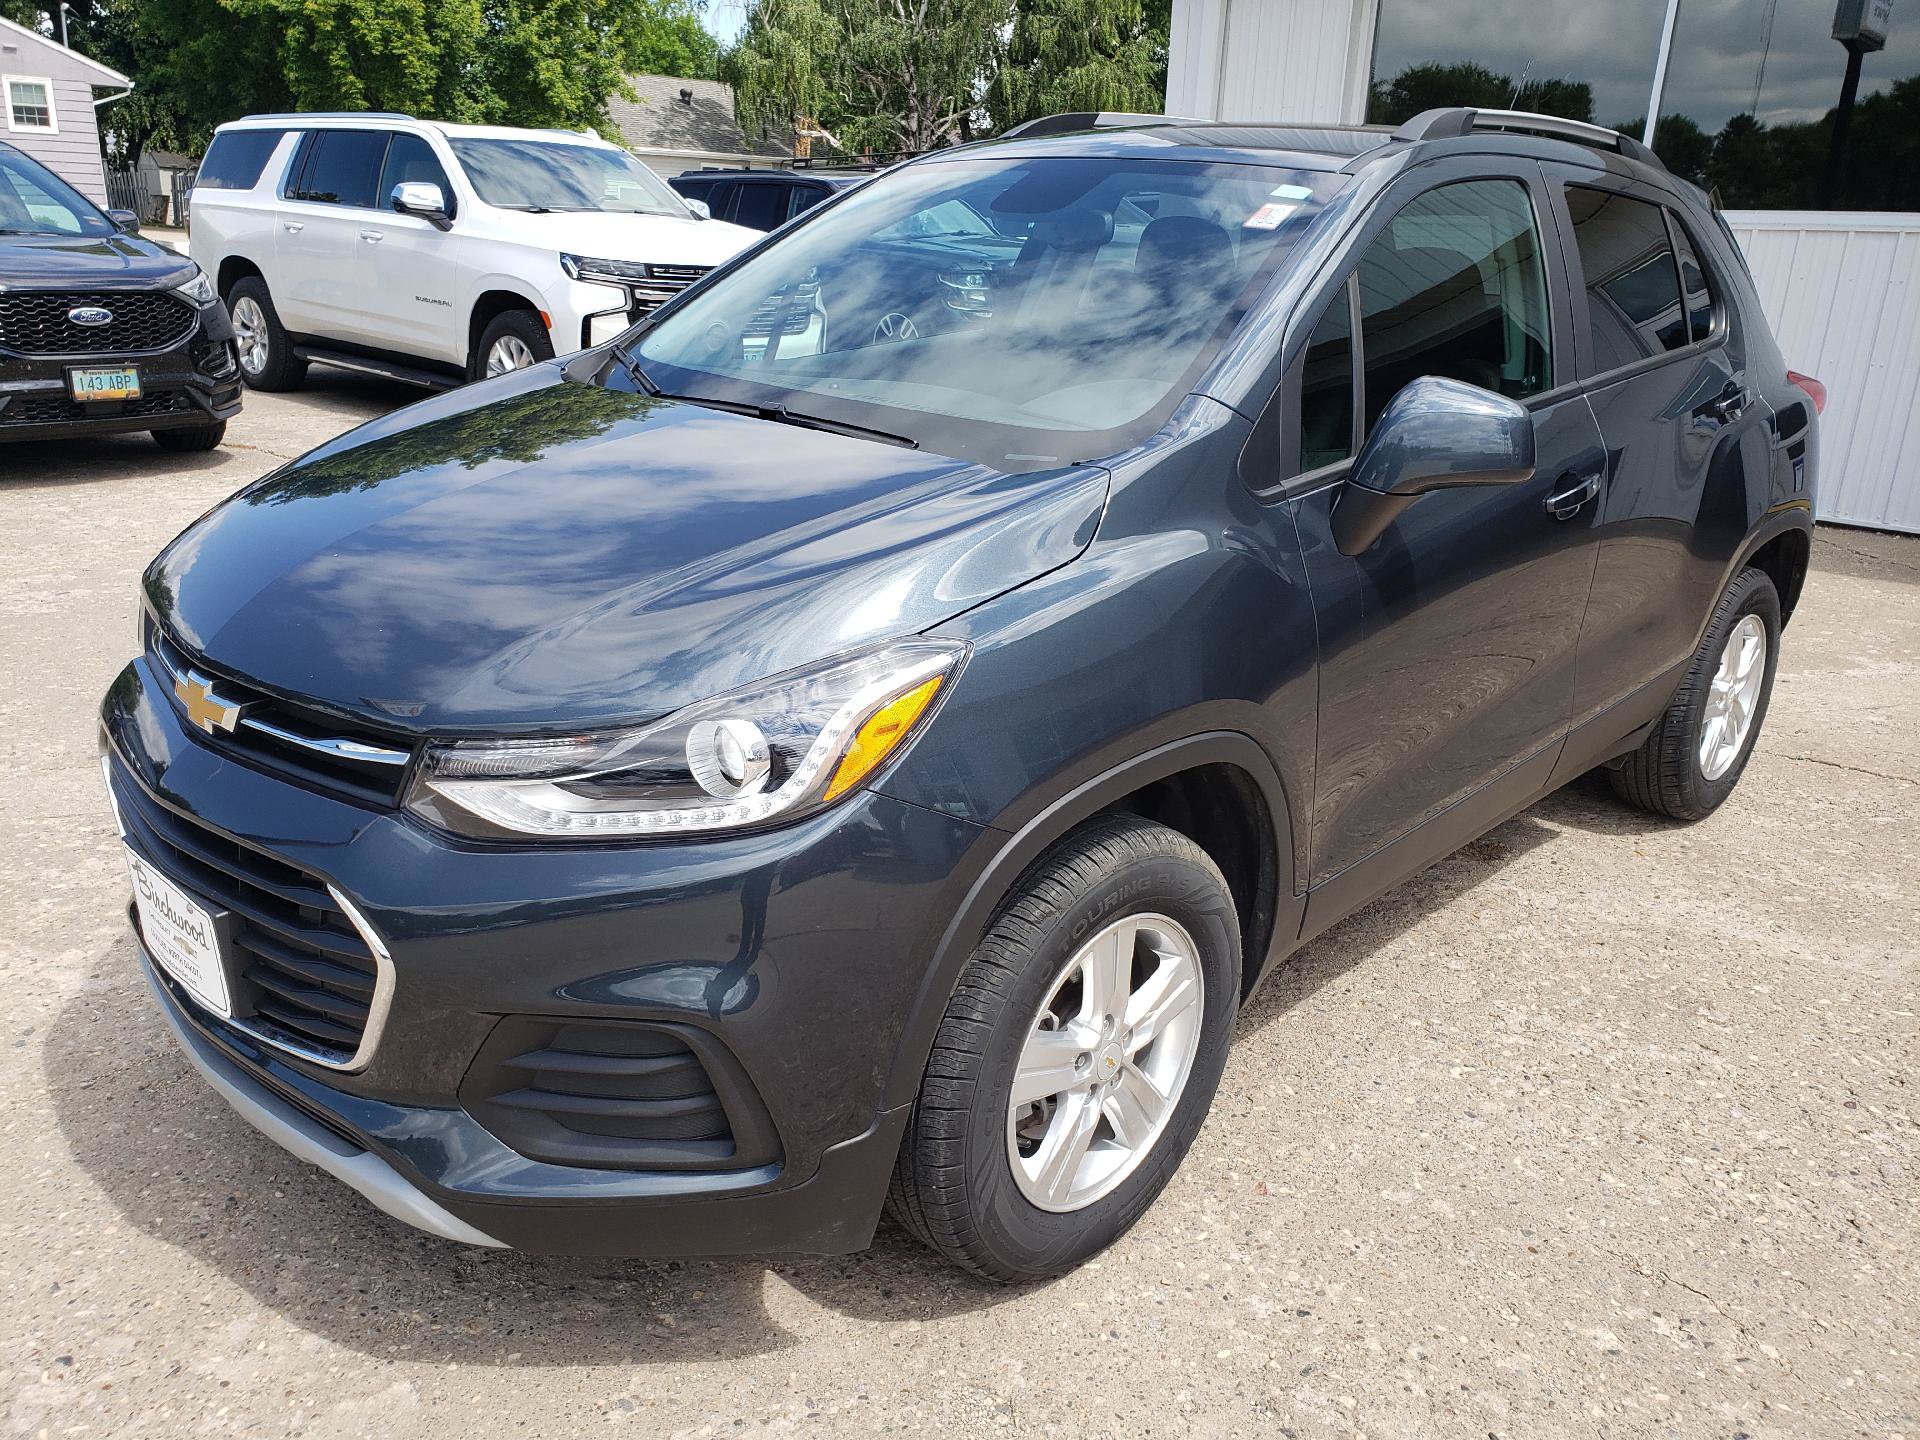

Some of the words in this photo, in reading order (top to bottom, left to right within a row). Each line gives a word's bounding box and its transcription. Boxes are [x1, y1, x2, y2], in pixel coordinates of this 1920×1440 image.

[415, 295, 453, 308] SUBURBAN
[80, 311, 104, 321] Ford
[80, 377, 103, 391] 143
[109, 375, 131, 390] ABP
[131, 860, 210, 951] Birchwood
[1057, 877, 1151, 953] TOURING
